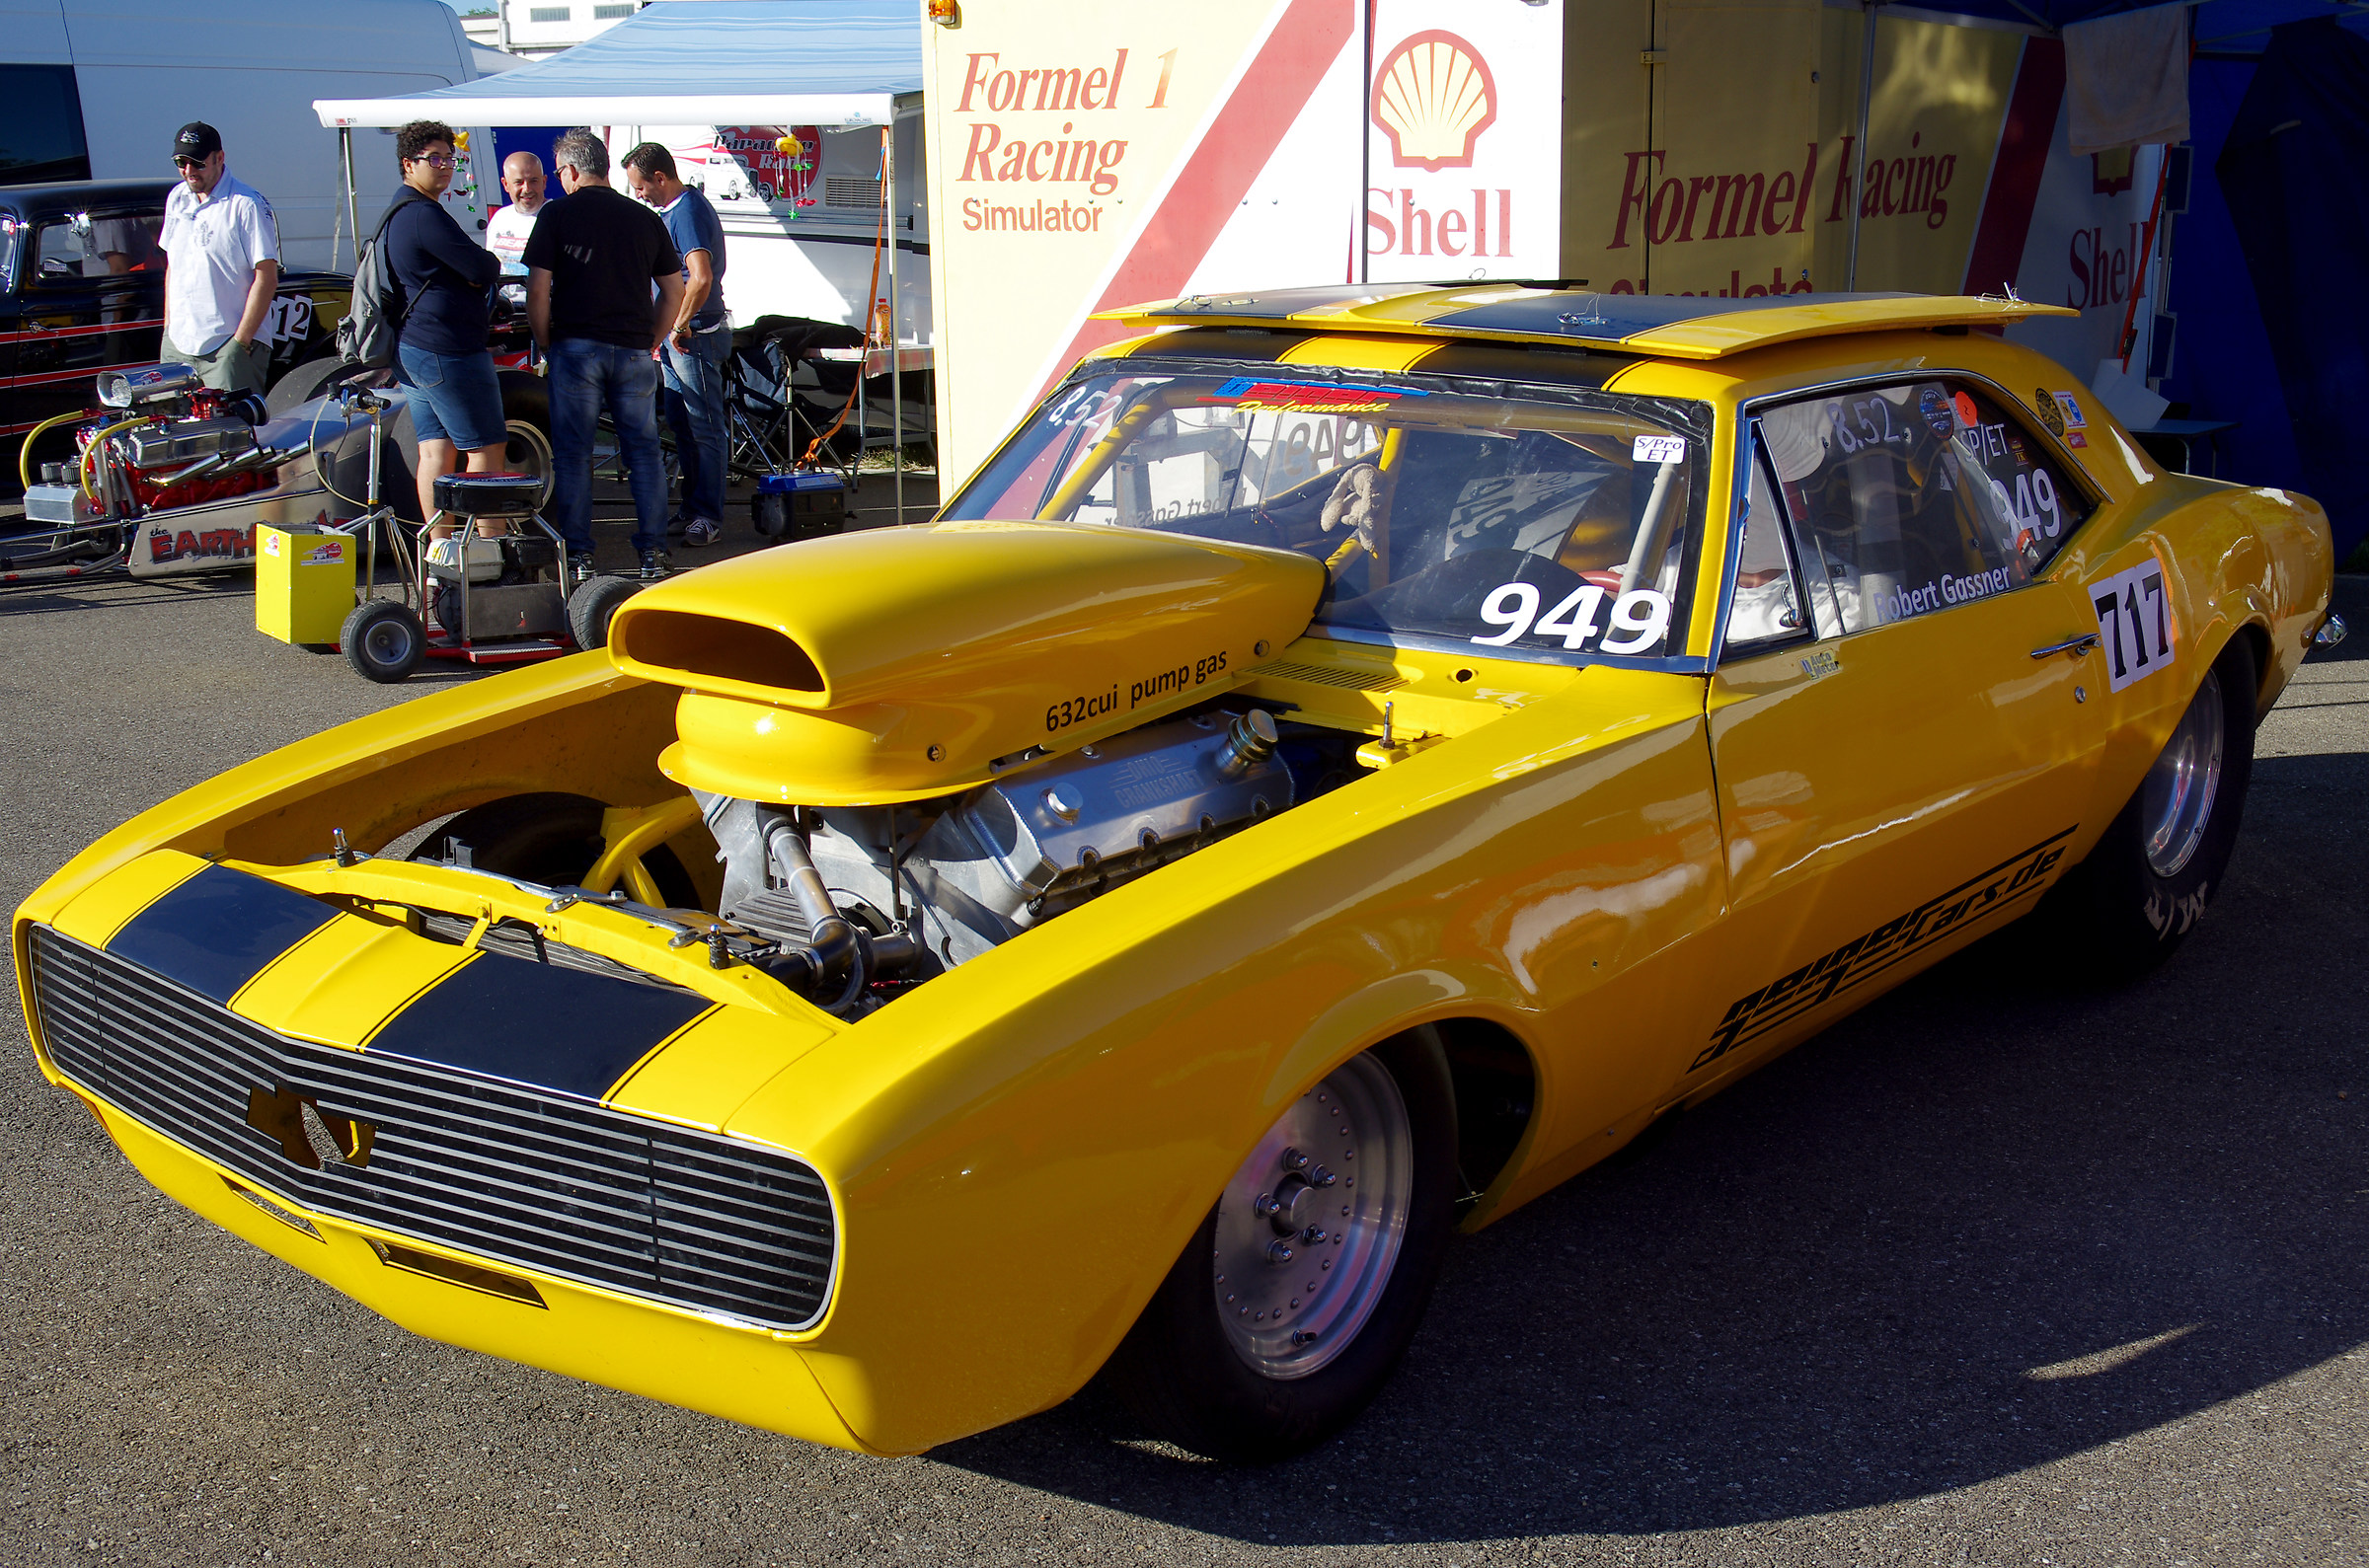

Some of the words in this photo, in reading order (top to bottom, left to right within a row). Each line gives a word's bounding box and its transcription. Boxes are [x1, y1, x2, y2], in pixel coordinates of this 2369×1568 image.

[954, 48, 1129, 112] Formel
[1145, 47, 1179, 109] 1
[955, 122, 1129, 195] Racing
[962, 197, 1104, 232] Simulator
[1366, 187, 1513, 257] Shell
[1606, 143, 1817, 250] Formel
[270, 301, 311, 336] 12
[1231, 400, 1390, 415] Performance
[1636, 437, 1682, 450] S/Pro
[1646, 449, 1673, 461] ET
[1990, 468, 2061, 551] 949
[1470, 582, 1671, 654] 949
[1873, 584, 1940, 623] Robert
[1942, 565, 2010, 604] Gassner
[2095, 572, 2169, 679] 717
[1810, 652, 1831, 666] Auto
[1046, 683, 1117, 731] 632cui
[1130, 665, 1189, 709] pump
[1195, 650, 1227, 685] gas
[1114, 769, 1205, 808] CRANKSHAFT
